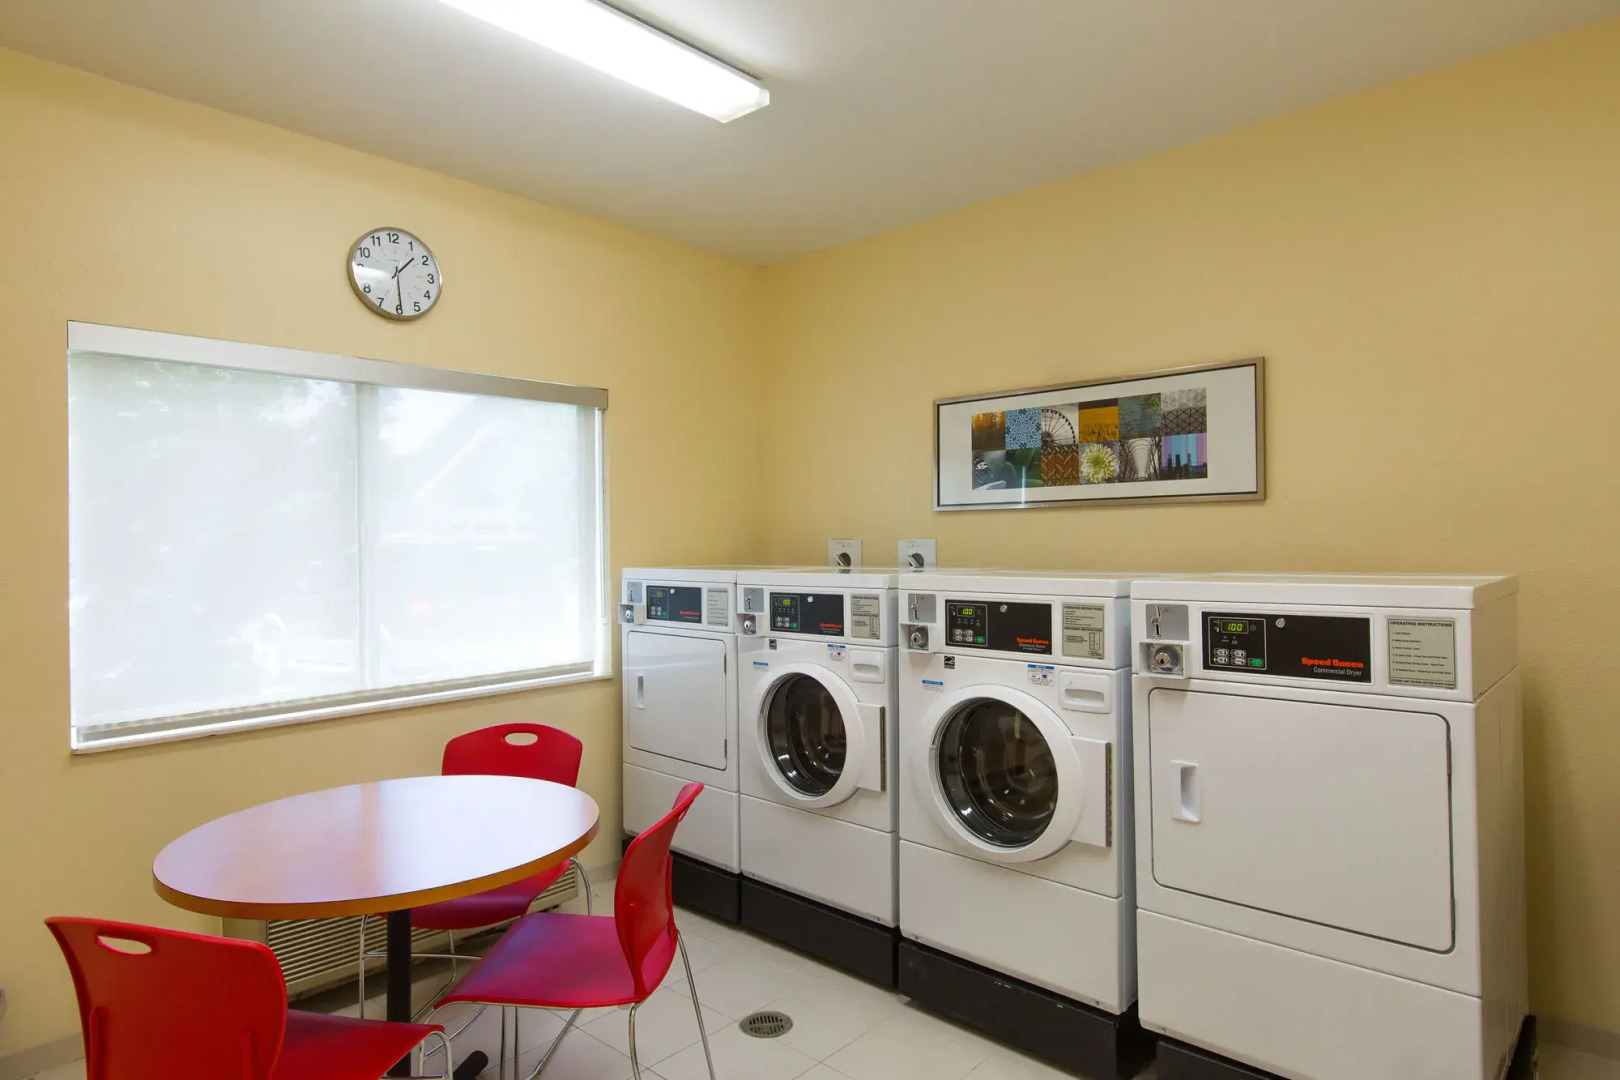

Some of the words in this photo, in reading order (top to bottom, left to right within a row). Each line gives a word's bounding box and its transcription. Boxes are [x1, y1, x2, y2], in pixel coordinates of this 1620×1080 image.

[370, 235, 381, 247] 11
[386, 232, 400, 244] 12
[408, 240, 414, 251] 1
[357, 246, 371, 258] 10
[421, 255, 429, 266] 2
[427, 273, 435, 284] 3
[363, 283, 371, 294] 8
[423, 290, 431, 300] 4
[377, 297, 384, 307] 7
[413, 301, 421, 312] 5
[395, 304, 404, 315] 6
[1227, 623, 1243, 631] 100
[1302, 657, 1331, 666] Speed
[1332, 658, 1364, 668] Queen
[1313, 666, 1346, 675] Commercial
[1346, 669, 1362, 677] Dryer
